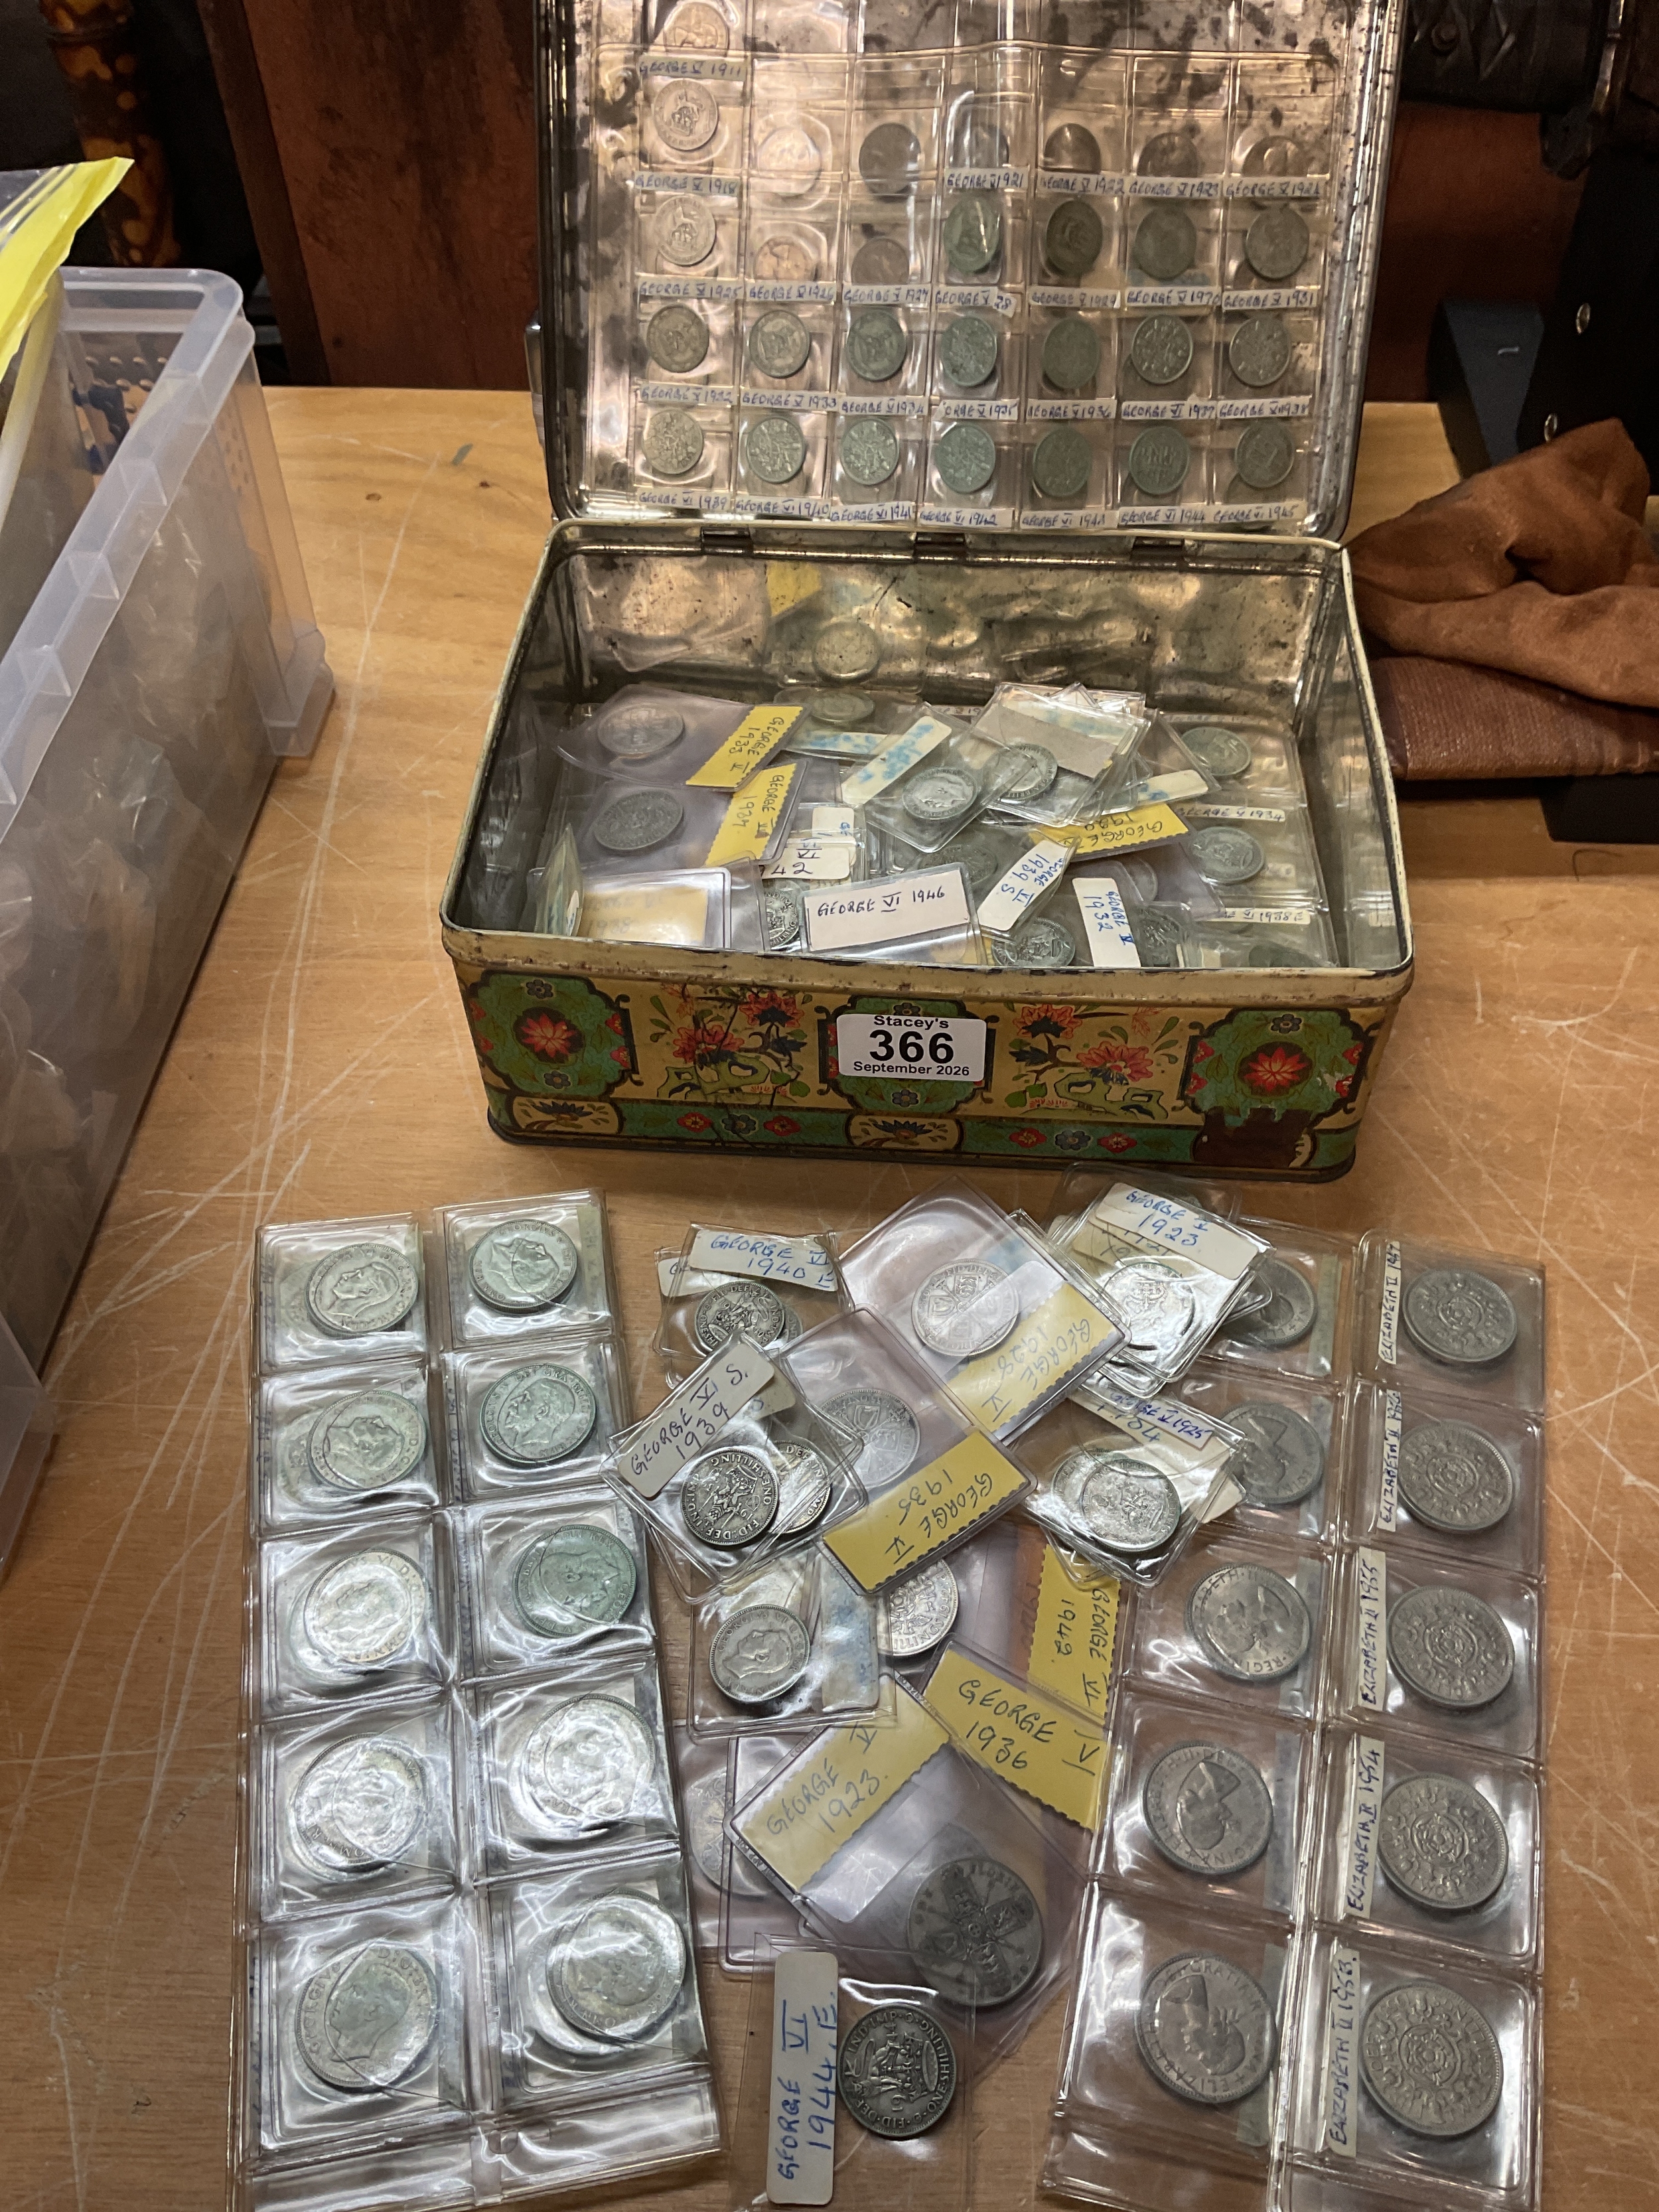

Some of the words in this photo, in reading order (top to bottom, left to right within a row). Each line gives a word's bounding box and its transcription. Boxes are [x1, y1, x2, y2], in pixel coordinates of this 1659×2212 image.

[640, 60, 687, 78] GEORGE
[690, 60, 705, 74] V
[711, 62, 741, 76] 1911
[636, 175, 687, 190] GEORGE
[691, 177, 703, 191] V
[709, 179, 739, 194] 1918
[997, 172, 1024, 188] 1921
[1095, 176, 1125, 194] 1922
[639, 282, 690, 295] GEORGE
[696, 283, 705, 296] V
[710, 285, 742, 299] 1925
[750, 285, 792, 300] GEORGE
[797, 286, 806, 299] V
[809, 286, 834, 299] 1926
[936, 289, 979, 305] GEORGE
[743, 392, 790, 406] GEORGE
[794, 394, 804, 407] V
[809, 394, 837, 408] 1933
[842, 402, 881, 413] GEORGE
[886, 398, 895, 413] V
[1220, 402, 1264, 417] GEORGE
[735, 499, 778, 513] GEORGE
[782, 498, 795, 514] VI
[798, 501, 829, 516] 1940
[831, 508, 873, 522] GEORGE
[877, 504, 887, 519] VI
[891, 504, 912, 520] 1941
[729, 727, 760, 754] 1933
[748, 717, 784, 755] GEORGE
[762, 774, 784, 812] GEORGE
[733, 796, 758, 828] 1937
[1087, 821, 1163, 847] GEORGE
[1012, 853, 1050, 881] 1939
[1035, 857, 1064, 887] GEORGE
[818, 899, 875, 917] GEORGE
[881, 891, 902, 913] VI
[912, 885, 945, 903] 1946
[1001, 883, 1015, 894] S
[1012, 888, 1035, 907] VI
[1084, 896, 1114, 932] 1932
[1106, 891, 1129, 927] GEORGE
[873, 1015, 949, 1030] Stacey's
[869, 1029, 954, 1064] 366
[853, 1061, 932, 1074] September
[936, 1065, 970, 1076] 2026
[1127, 1191, 1187, 1220] GEORGE
[1194, 1217, 1213, 1231] V
[1138, 1214, 1199, 1246] 1923
[711, 1234, 794, 1258] GEORGE
[806, 1250, 830, 1265] VI
[747, 1259, 806, 1278] 1940
[997, 1326, 1048, 1379] 1928
[1020, 1319, 1090, 1390] GEORGE
[981, 1394, 1012, 1422] V
[632, 1408, 693, 1475] GEORGE
[690, 1377, 719, 1411] VI
[676, 1402, 730, 1460] 1939
[1158, 1409, 1179, 1424] V
[1173, 1418, 1213, 1439] 1925
[711, 1454, 767, 1478] SHILLING
[899, 1469, 953, 1526] 1935
[1381, 1443, 1398, 1523] ELIZABETH
[919, 1473, 993, 1538] GEORGE
[885, 1535, 914, 1564] V
[719, 1611, 768, 1652] GEORGIVS
[1090, 1588, 1111, 1662] GEORGE
[1082, 1672, 1109, 1707] VI
[959, 1679, 1056, 1743] GEORGE
[1062, 1729, 1100, 1777] V
[966, 1721, 1029, 1770] 1936
[766, 1757, 839, 1836] GEORGE
[849, 1722, 878, 1754] V
[782, 1999, 809, 2054] VI
[919, 2020, 950, 2083] SHILLING
[1329, 2037, 1349, 2145] ELIZABETH
[777, 2077, 800, 2180] GEORGE
